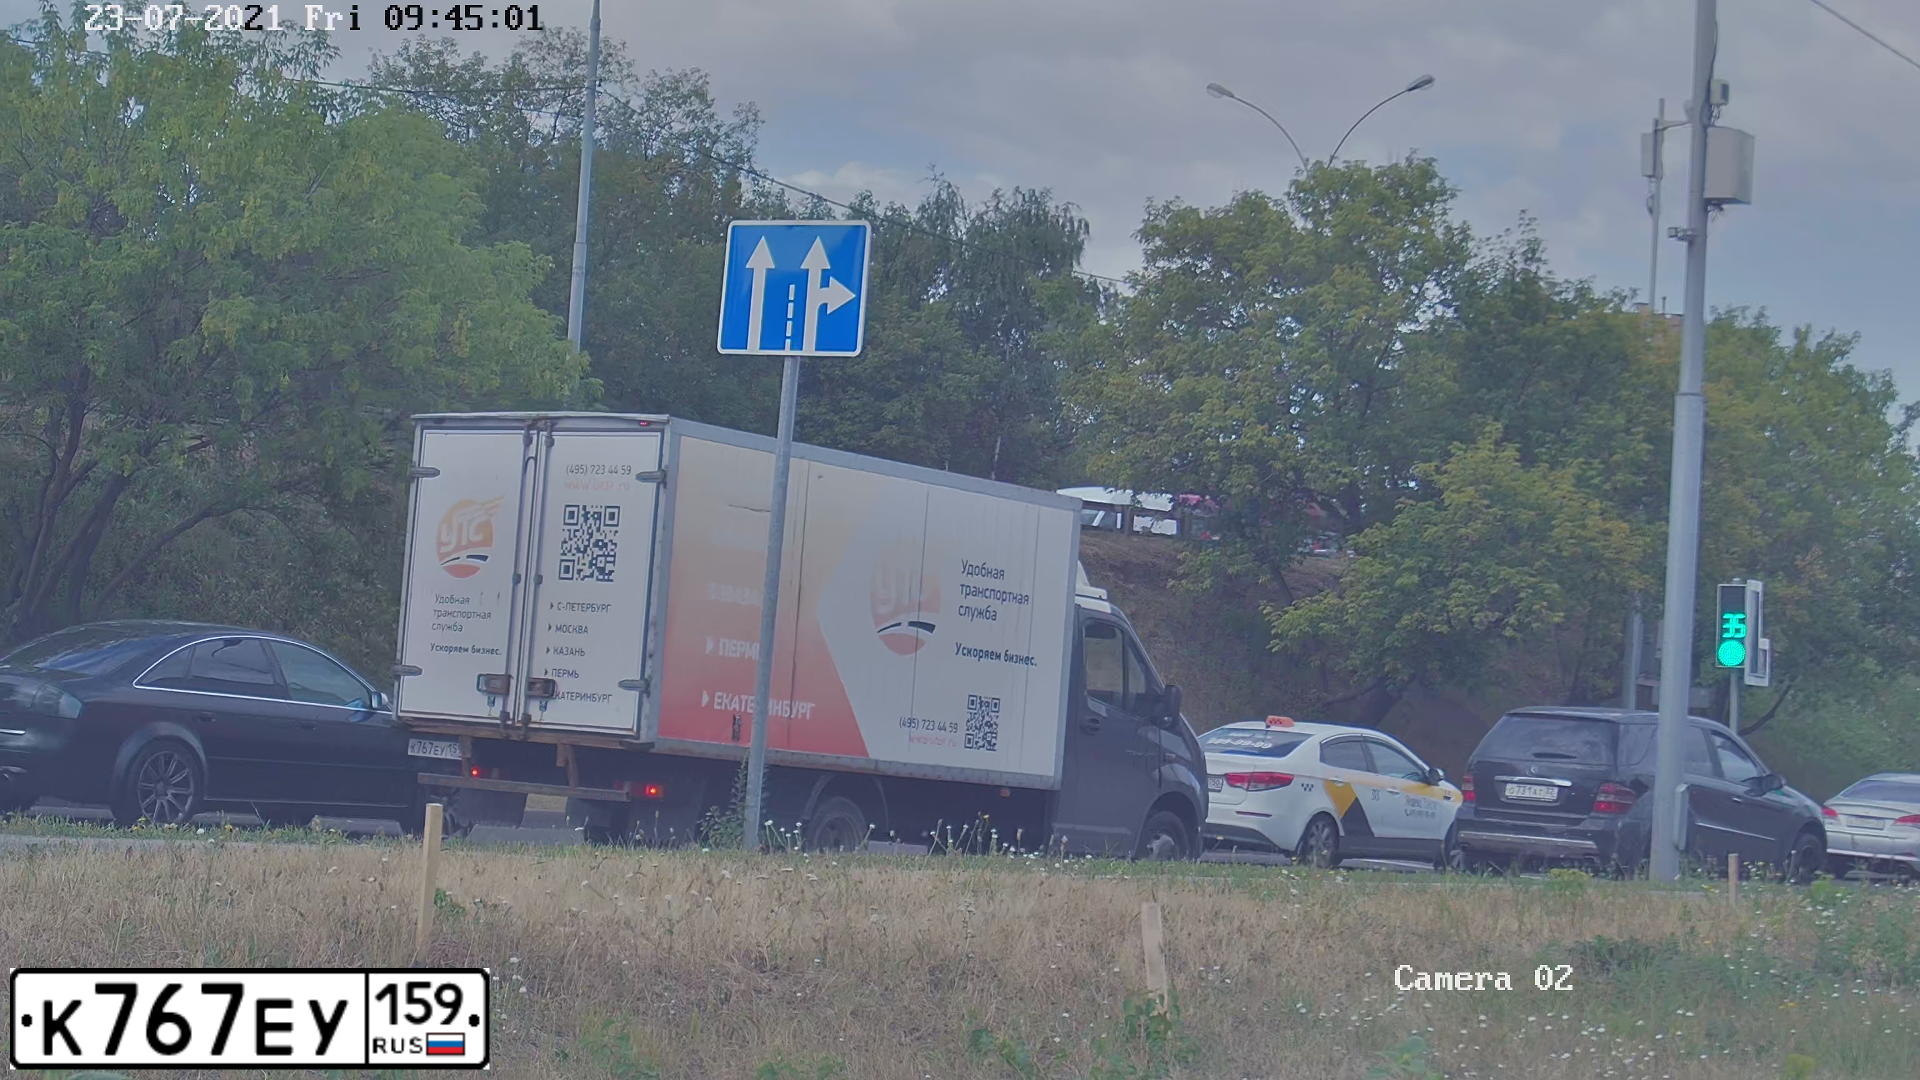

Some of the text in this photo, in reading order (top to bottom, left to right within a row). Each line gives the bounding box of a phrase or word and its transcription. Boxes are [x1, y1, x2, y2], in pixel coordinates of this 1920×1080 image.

[565, 464, 632, 476] (495) 723 44 59
[961, 558, 1005, 581] Удобная
[434, 593, 470, 605] Удобная
[959, 583, 1030, 606] транспортная
[556, 602, 612, 613] С-ПЕТЕРБУРГ
[957, 604, 998, 622] служба
[433, 609, 492, 619] транспортная
[431, 621, 463, 633] служба
[555, 624, 589, 634] МОСКВА
[430, 642, 502, 656] Ускоряем бизнес.
[553, 646, 586, 657] КАЗАНЬ
[955, 642, 1038, 667] Ускоряем бизнес.
[551, 668, 580, 679] ПЕРМЬ
[552, 690, 613, 703] КАТЕРИНБУРГ
[899, 716, 959, 734] (495) 723 44 59
